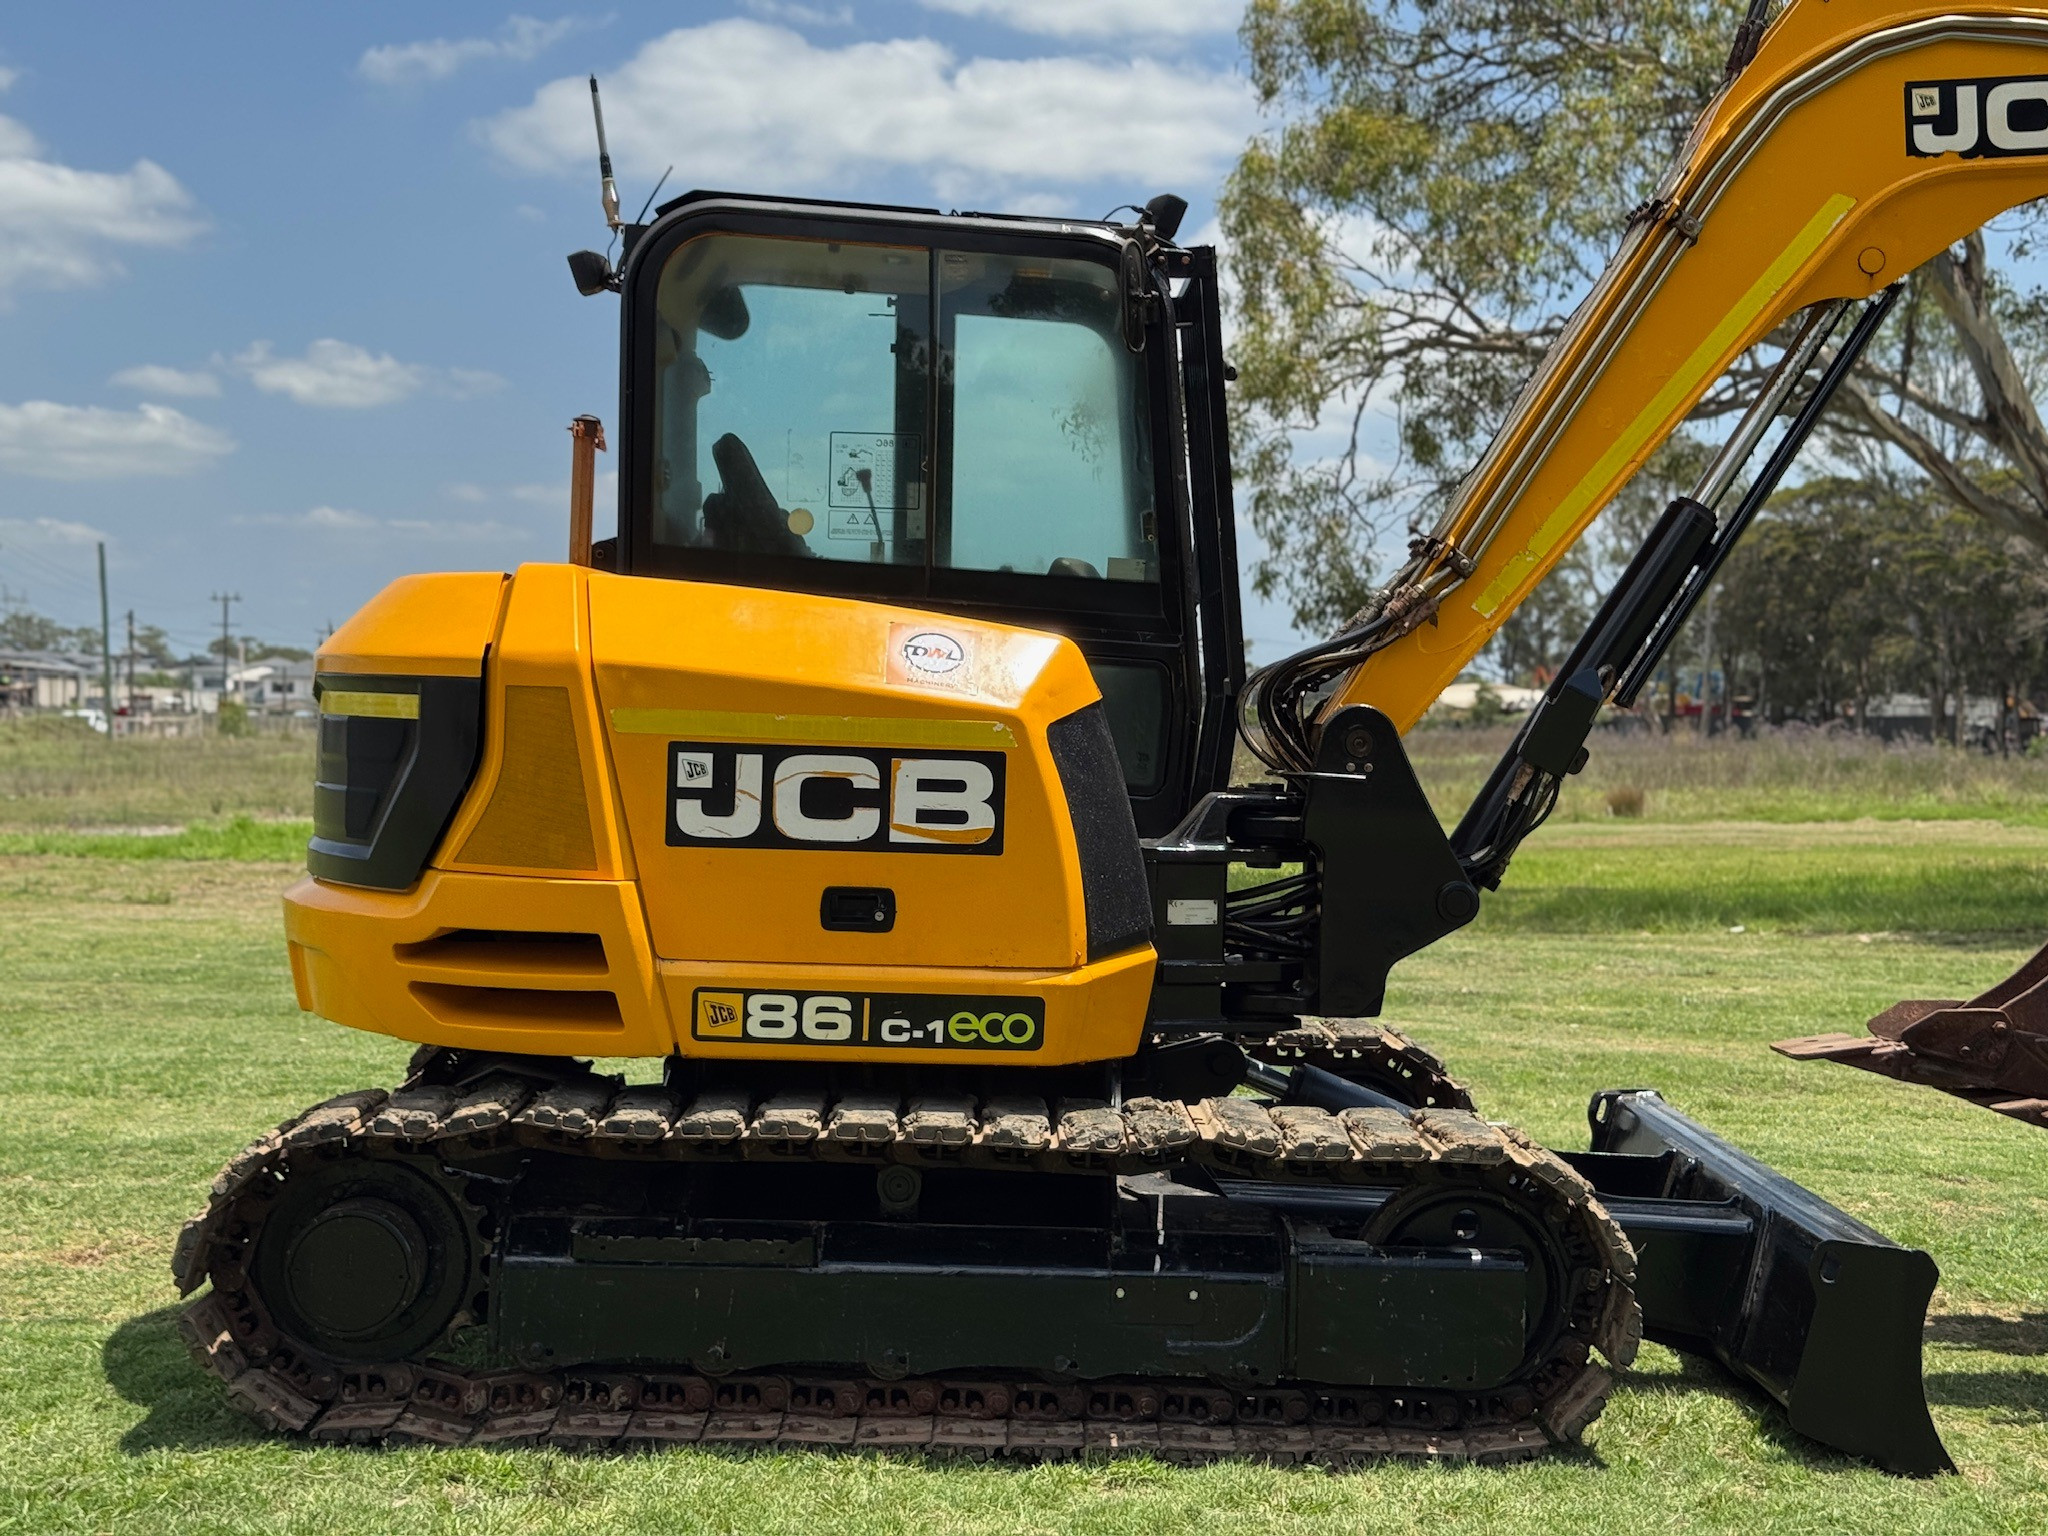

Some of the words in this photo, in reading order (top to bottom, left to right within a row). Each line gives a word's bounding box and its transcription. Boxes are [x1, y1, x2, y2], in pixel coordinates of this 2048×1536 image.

[687, 761, 707, 778] JCB
[676, 753, 996, 845] JCB
[710, 1004, 735, 1025] JCB
[746, 993, 852, 1041] 86
[948, 1012, 1036, 1044] eco
